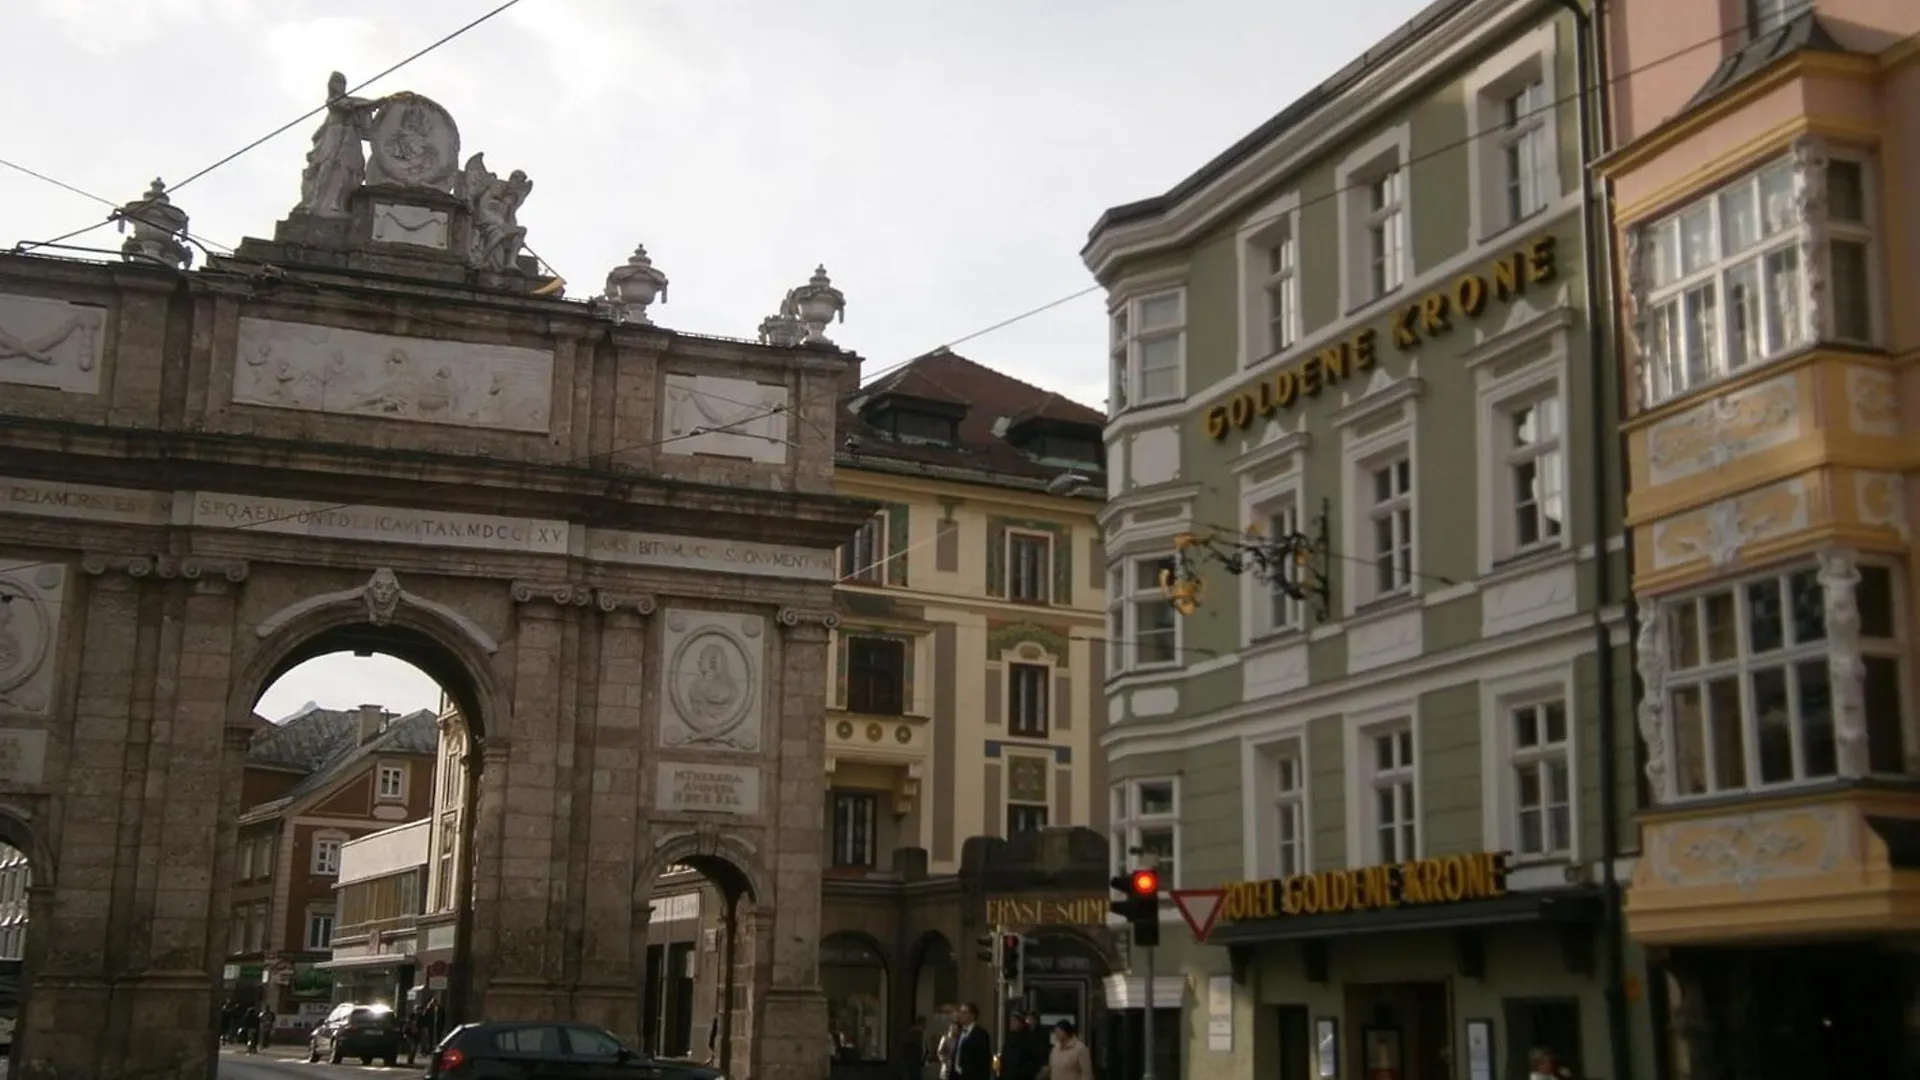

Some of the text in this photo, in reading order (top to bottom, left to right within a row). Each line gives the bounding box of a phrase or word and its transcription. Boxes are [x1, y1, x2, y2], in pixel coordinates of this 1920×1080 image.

[1205, 233, 1557, 440] GOLDENE KRONE
[1282, 864, 1403, 915] GOLDENE
[1404, 852, 1509, 902] KRONE
